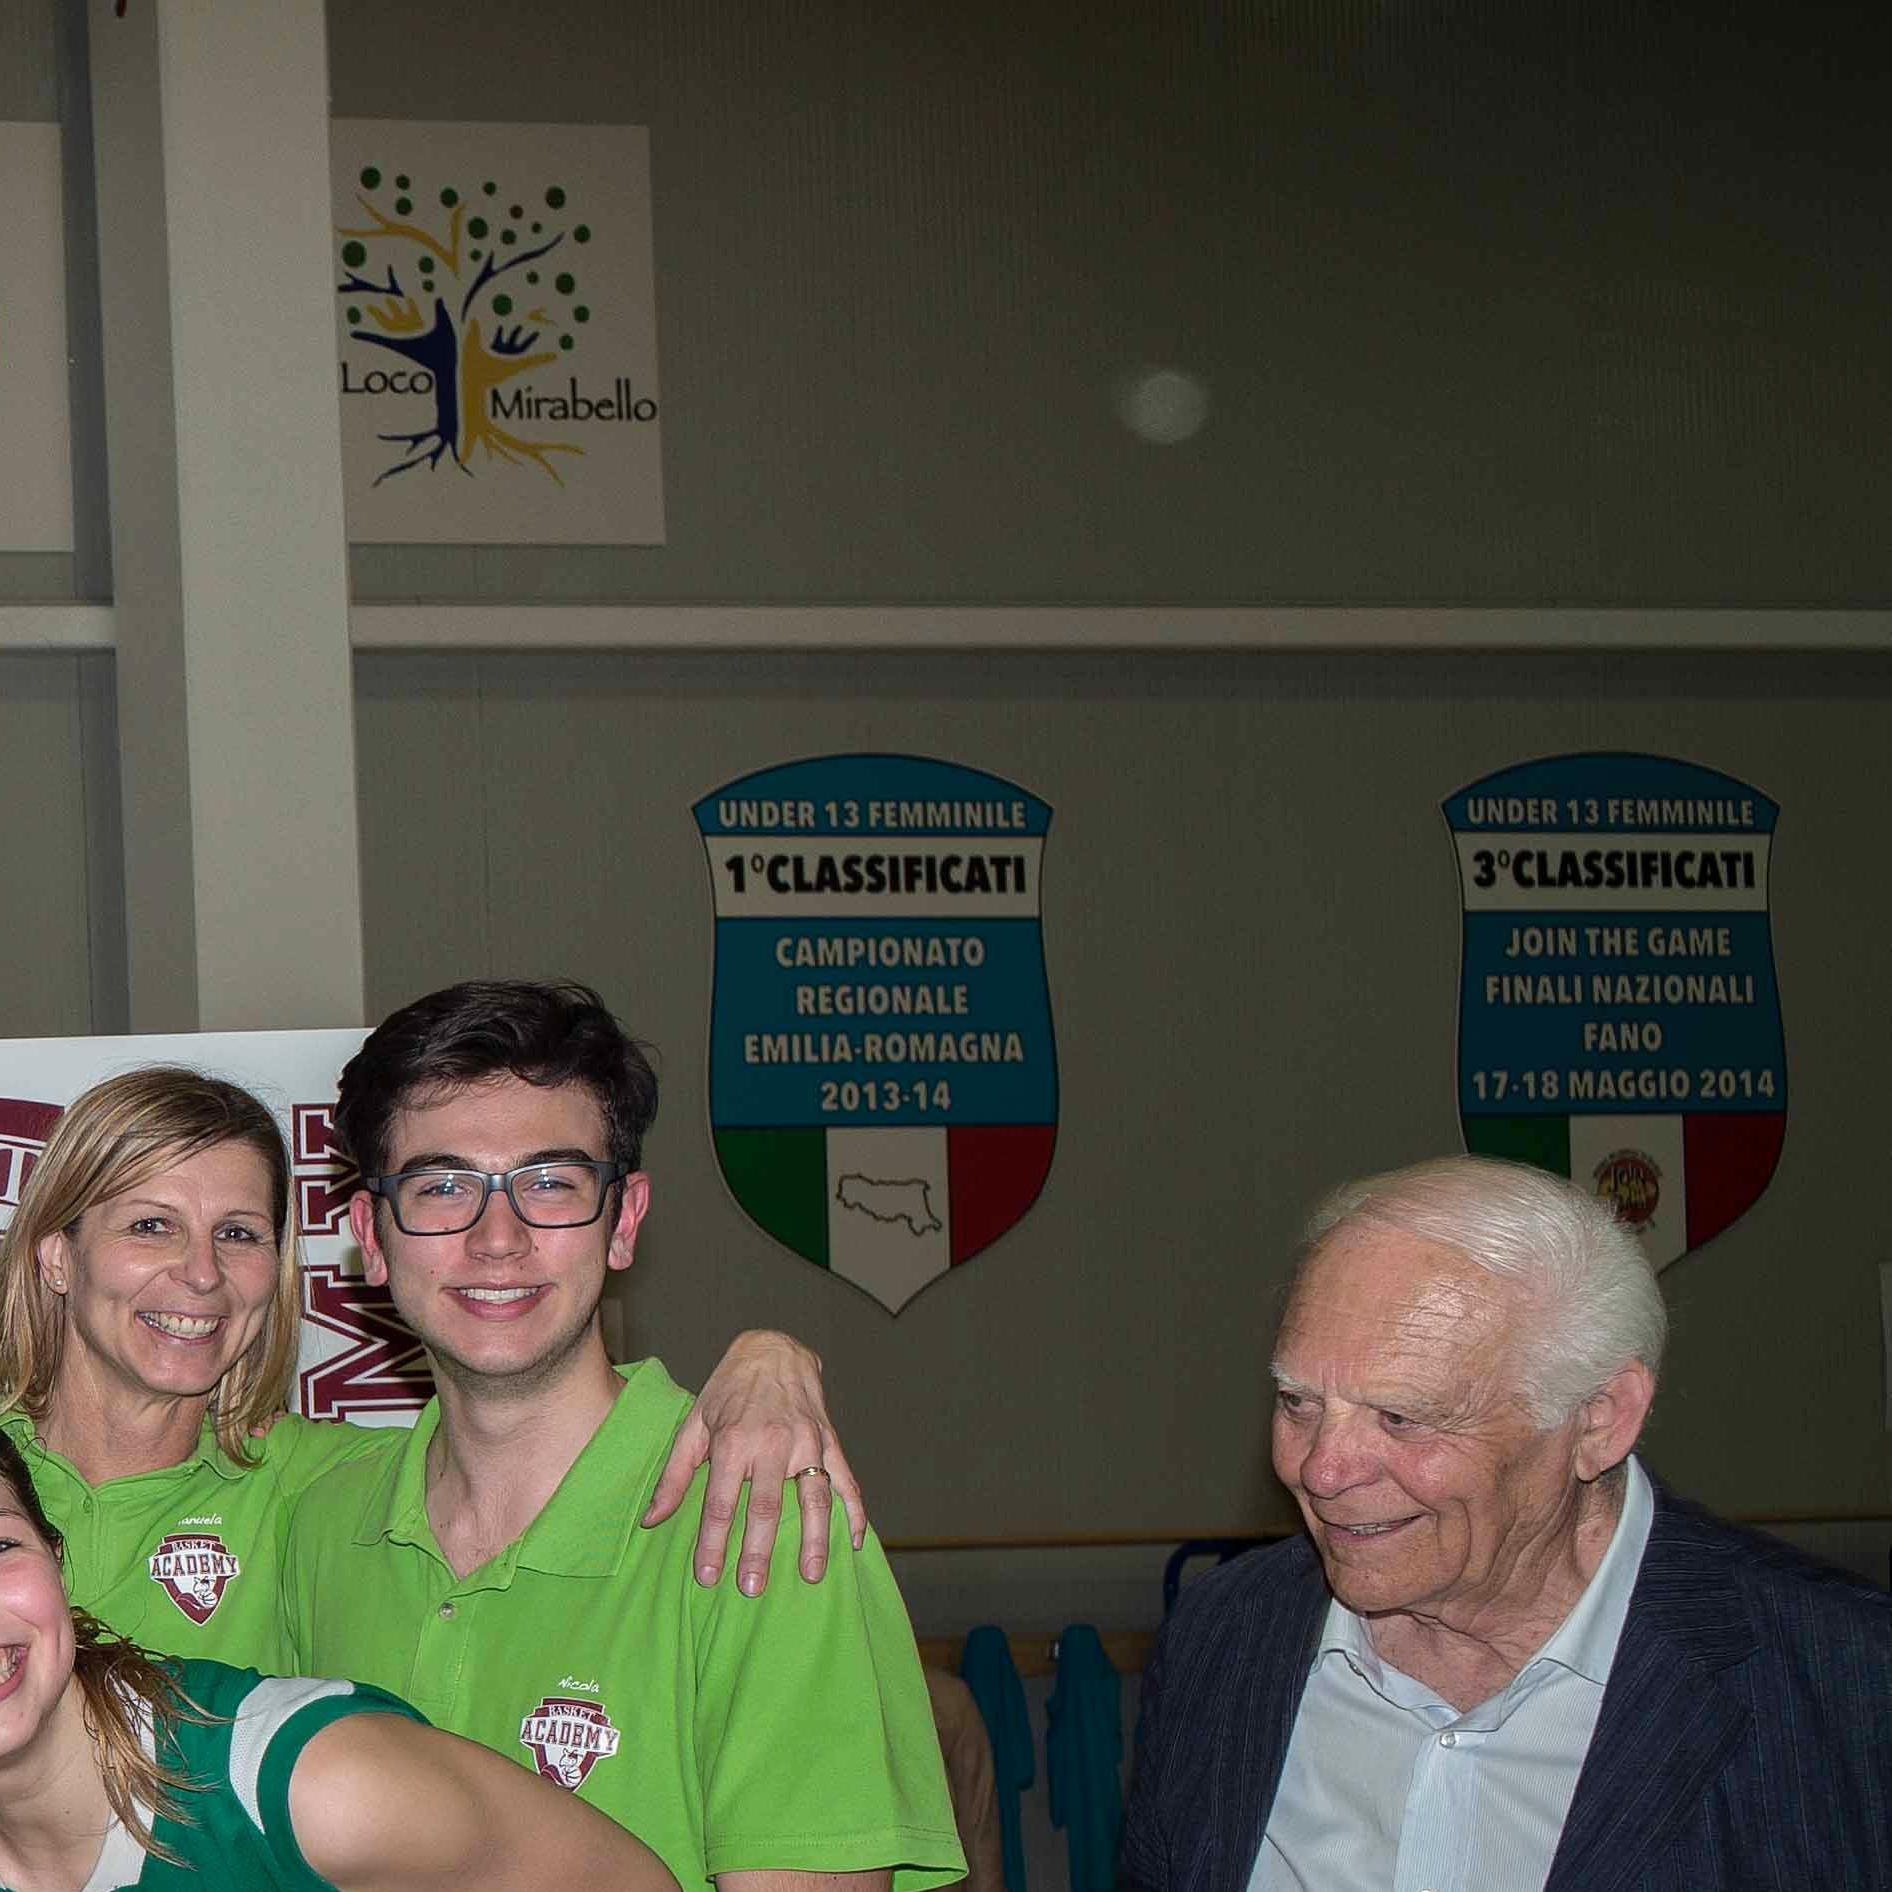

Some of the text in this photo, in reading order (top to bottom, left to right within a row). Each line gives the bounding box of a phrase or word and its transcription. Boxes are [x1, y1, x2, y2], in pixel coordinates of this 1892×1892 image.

[341, 362, 434, 395] Loco
[490, 377, 657, 422] Mirabello
[719, 800, 1026, 829] UNDER 13 FEMMINILE
[1467, 799, 1754, 826] UNDER 13 FEMMINILE
[775, 937, 985, 968] CAMPIONATO
[1505, 927, 1731, 957] JOIN THE GAME
[797, 986, 969, 1015] REGIONALE
[1486, 975, 1754, 1004] FINALI NAZIONALI
[744, 1033, 1024, 1064] EMILIA-ROMAGNA
[1584, 1022, 1663, 1052] FANO
[821, 1081, 951, 1111] 2013-14
[1473, 1070, 1775, 1100] 17-18 MAGGIO 2014
[178, 1513, 223, 1526] anuela
[151, 1554, 237, 1577] ACADEMY
[558, 1675, 600, 1693] Nicola
[521, 1719, 619, 1751] ACADEMY
